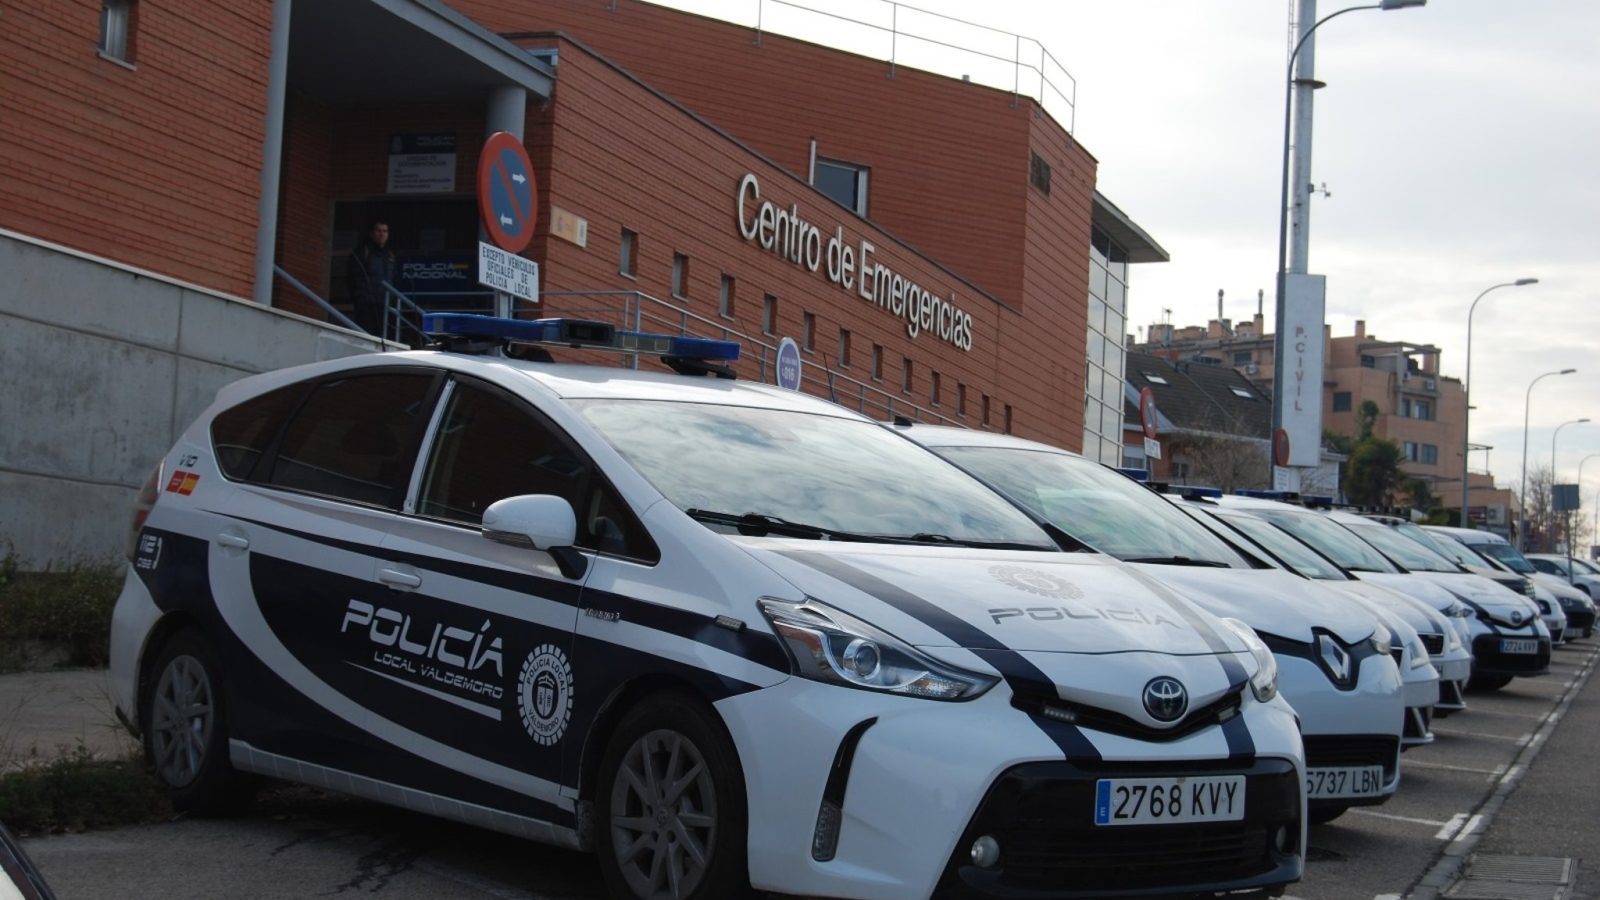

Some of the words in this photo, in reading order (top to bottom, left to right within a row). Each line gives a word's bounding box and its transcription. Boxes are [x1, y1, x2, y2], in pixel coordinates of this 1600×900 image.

[482, 246, 505, 265] EXCEPTO
[737, 173, 821, 273] Centro
[826, 225, 855, 290] de
[857, 239, 973, 352] Emergencias
[402, 271, 467, 280] NACIONAL
[486, 272, 508, 289] POLICIA
[514, 282, 531, 298] LOCAL
[487, 260, 514, 280] OFICIALES
[521, 273, 528, 285] DE
[1294, 341, 1306, 412] CIVIL
[987, 606, 1184, 630] POLICÍA
[340, 598, 504, 678] POLICÍA
[373, 650, 417, 674] LOCAL
[420, 663, 504, 700] VALDEMORO
[551, 660, 566, 694] LOCAL
[528, 707, 560, 733] VALDEMORO
[1306, 770, 1346, 795] 5737
[1352, 768, 1380, 793] LBN
[1113, 784, 1182, 819] 2768
[1191, 781, 1238, 816] KVY
